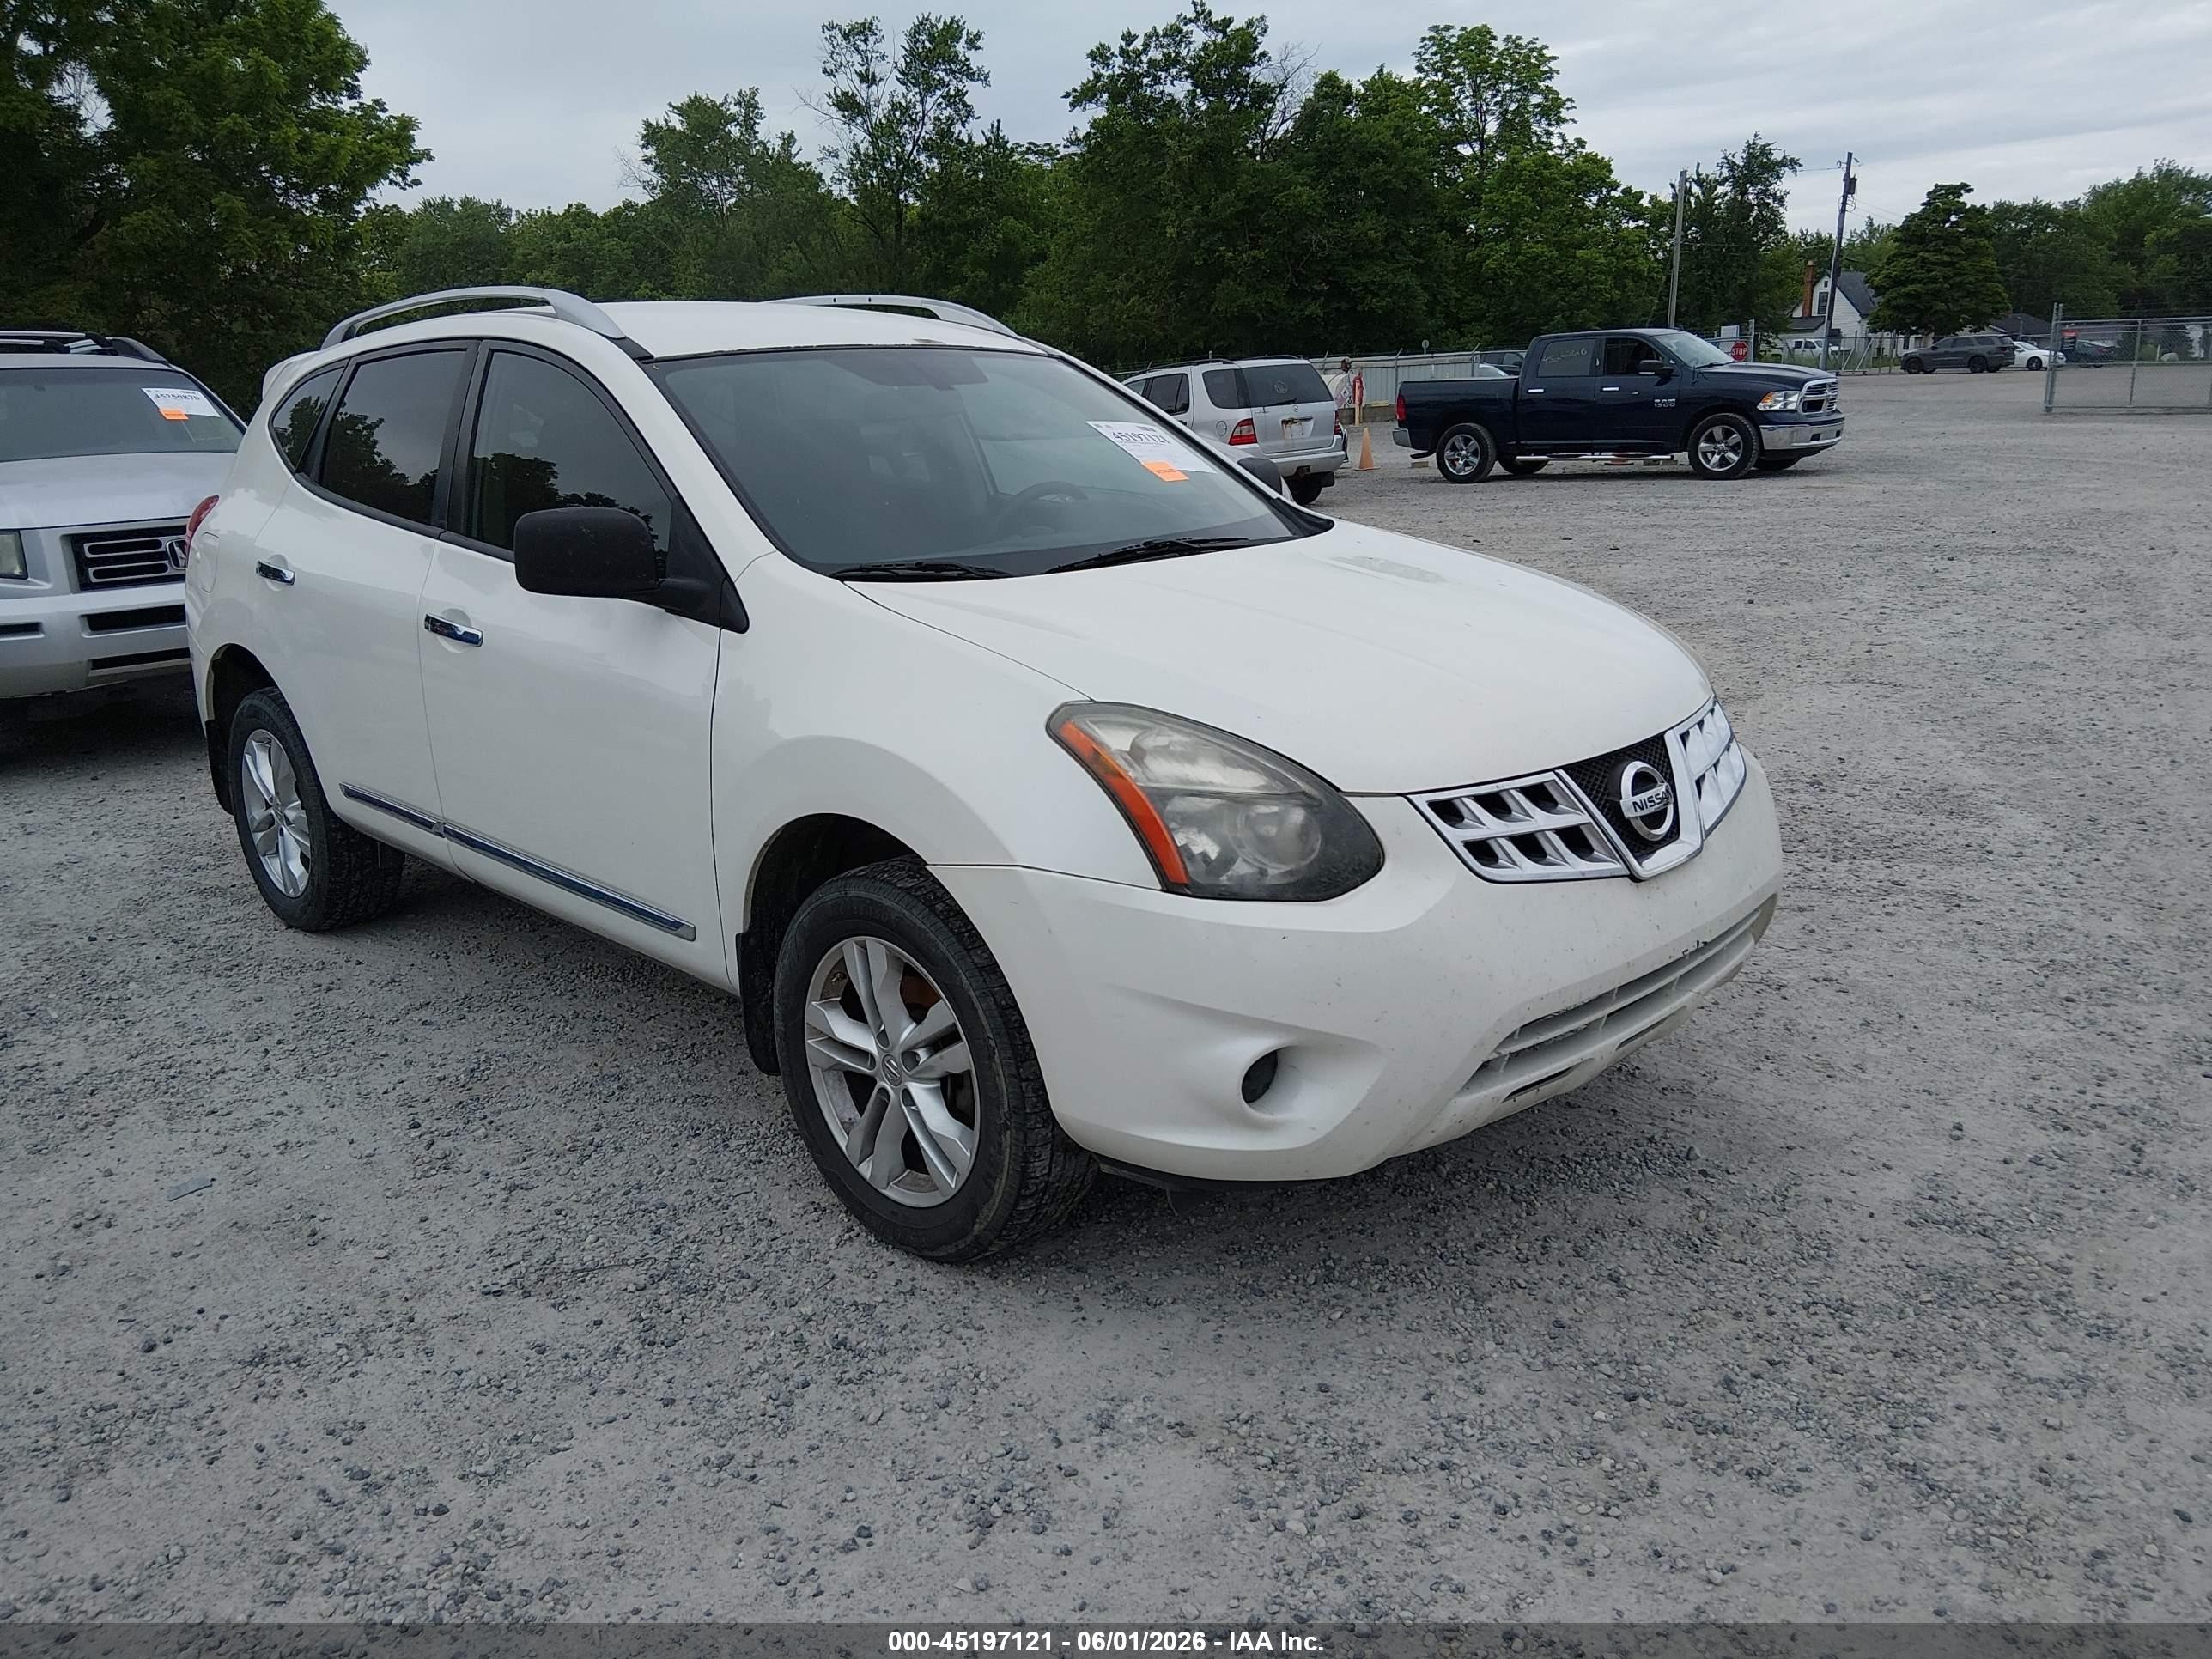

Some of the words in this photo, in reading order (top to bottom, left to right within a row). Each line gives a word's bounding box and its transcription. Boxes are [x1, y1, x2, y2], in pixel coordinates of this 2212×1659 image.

[1731, 347, 1747, 356] STOP
[1112, 431, 1171, 444] 45197121
[1632, 789, 1673, 813] NISSAN
